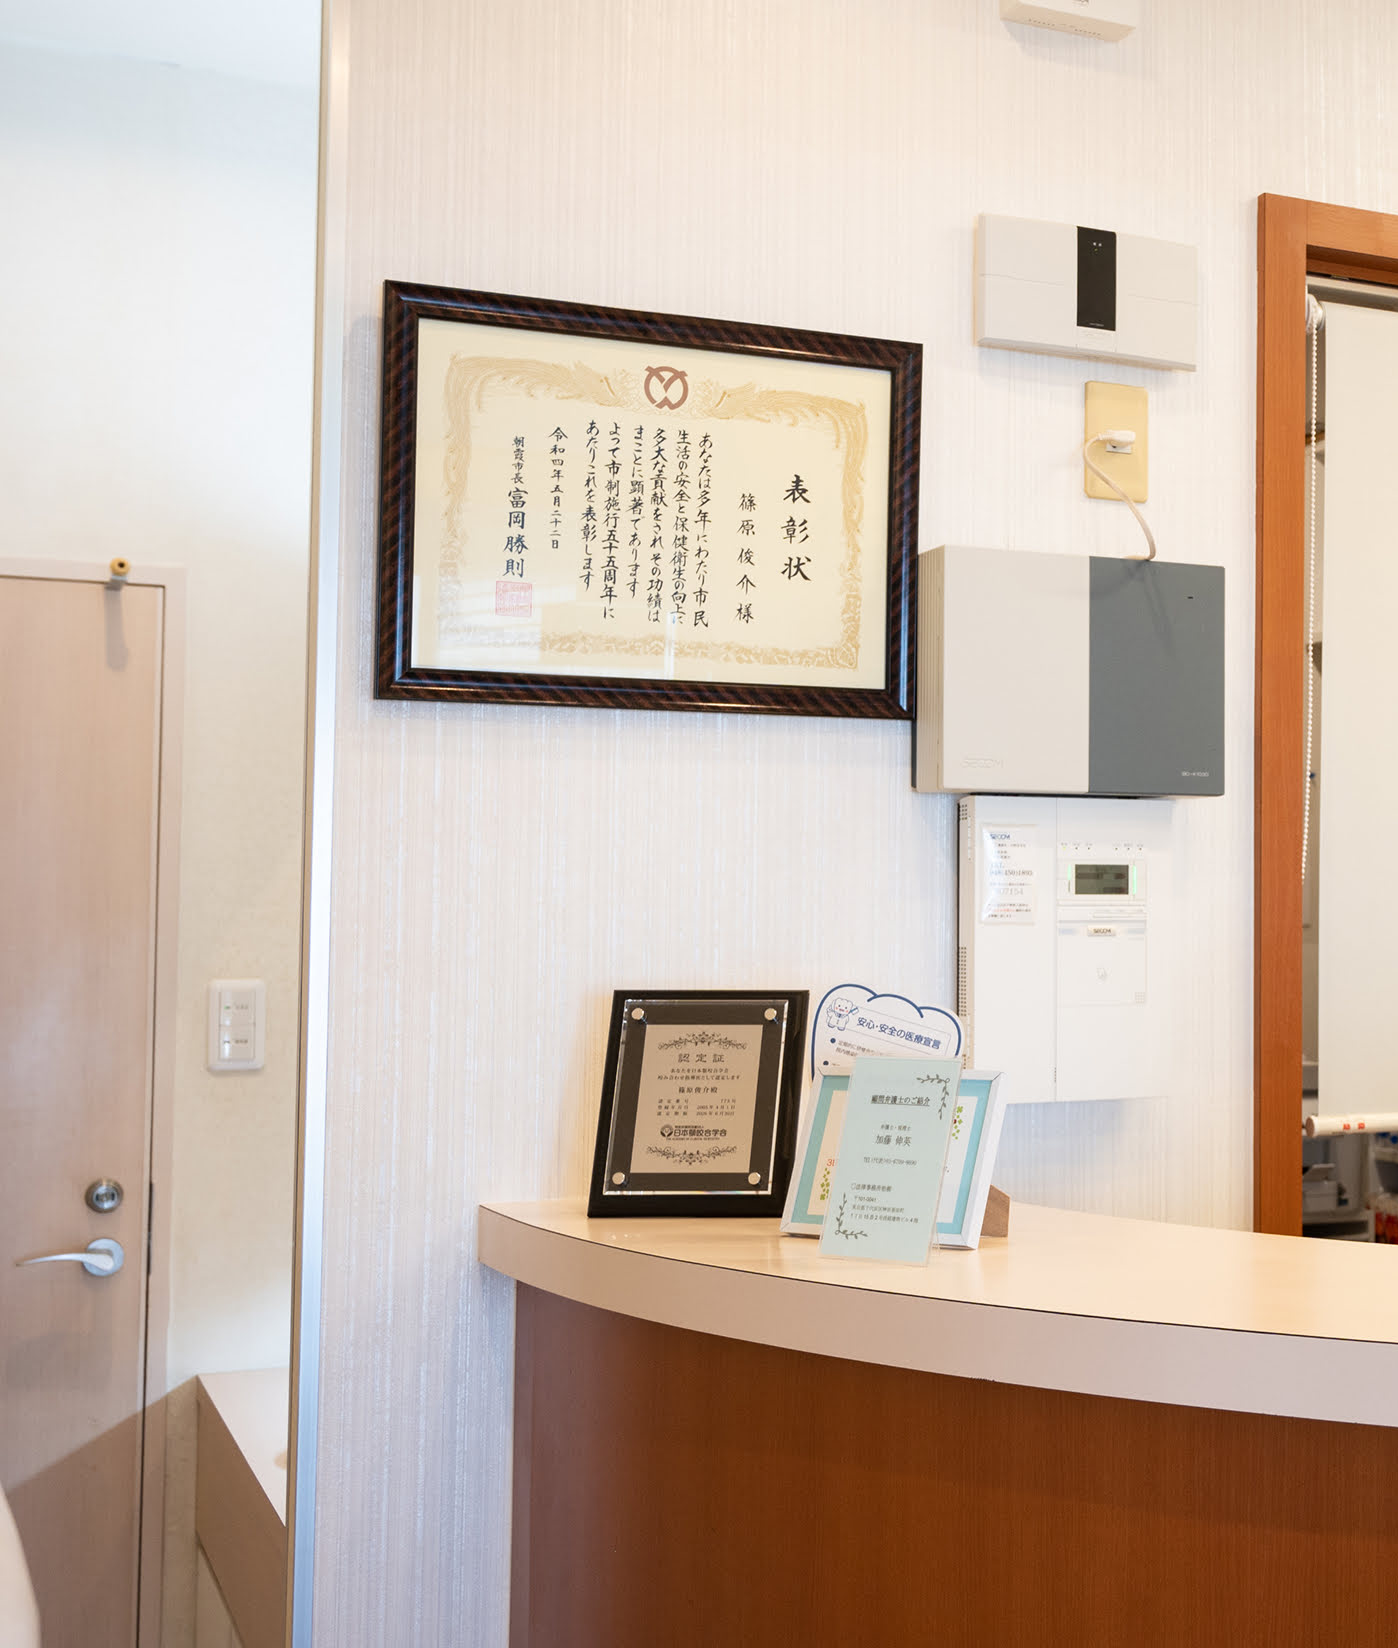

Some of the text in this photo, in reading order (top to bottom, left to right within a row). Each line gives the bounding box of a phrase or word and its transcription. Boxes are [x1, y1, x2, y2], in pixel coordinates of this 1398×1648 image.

[510, 435, 526, 485] 朝霞市長
[548, 426, 569, 550] 令和四年五月二十二日
[579, 419, 601, 592] あたりこれを表彰します
[600, 422, 622, 620] よって市制施行五十五周年に
[625, 424, 645, 599] まことに顕著であります
[502, 487, 529, 579] 富岡勝則
[669, 429, 692, 625] 生活の安全と保健衛生の向上に
[693, 432, 713, 628] あなたは多年にわたり市民
[736, 492, 757, 625] 篠原俊介様
[781, 474, 812, 582] 表彰状
[678, 1053, 725, 1063] 認定証
[856, 1016, 942, 1050] 安心・安全の医療宣言
